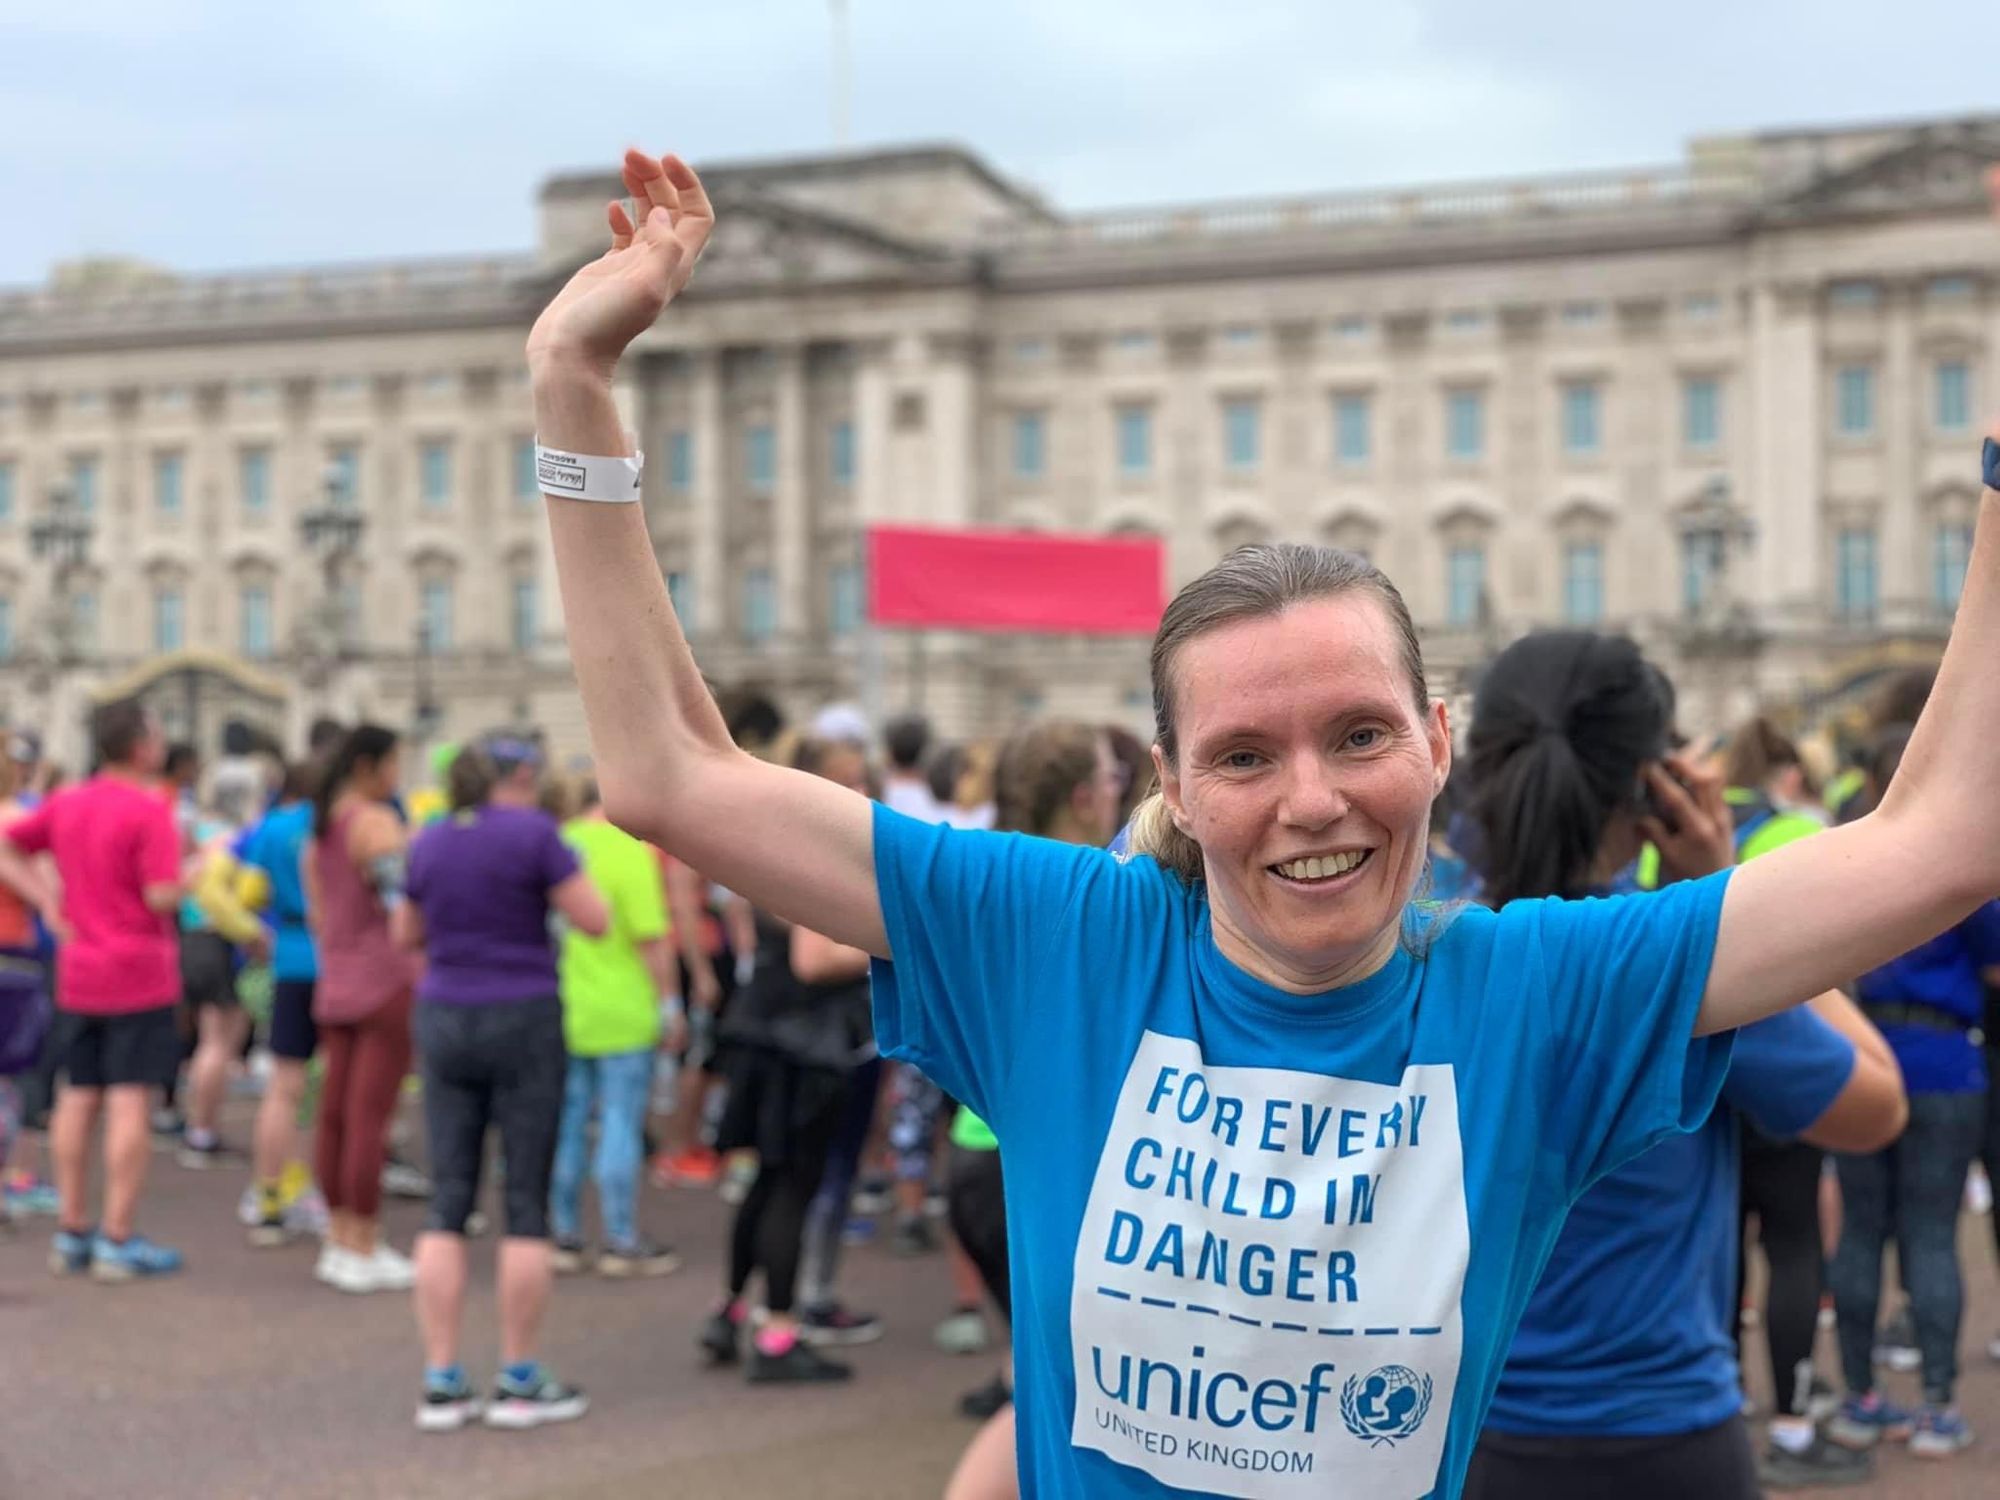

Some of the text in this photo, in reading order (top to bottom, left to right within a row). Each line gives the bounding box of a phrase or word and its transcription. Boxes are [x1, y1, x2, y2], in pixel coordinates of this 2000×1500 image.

[1145, 1066, 1428, 1159] FOR EVERY
[1124, 1136, 1383, 1227] CHILD IN
[1104, 1209, 1359, 1304] DANGER
[1091, 1345, 1336, 1434] unicef
[1095, 1406, 1314, 1474] UNITED KINGDOM
